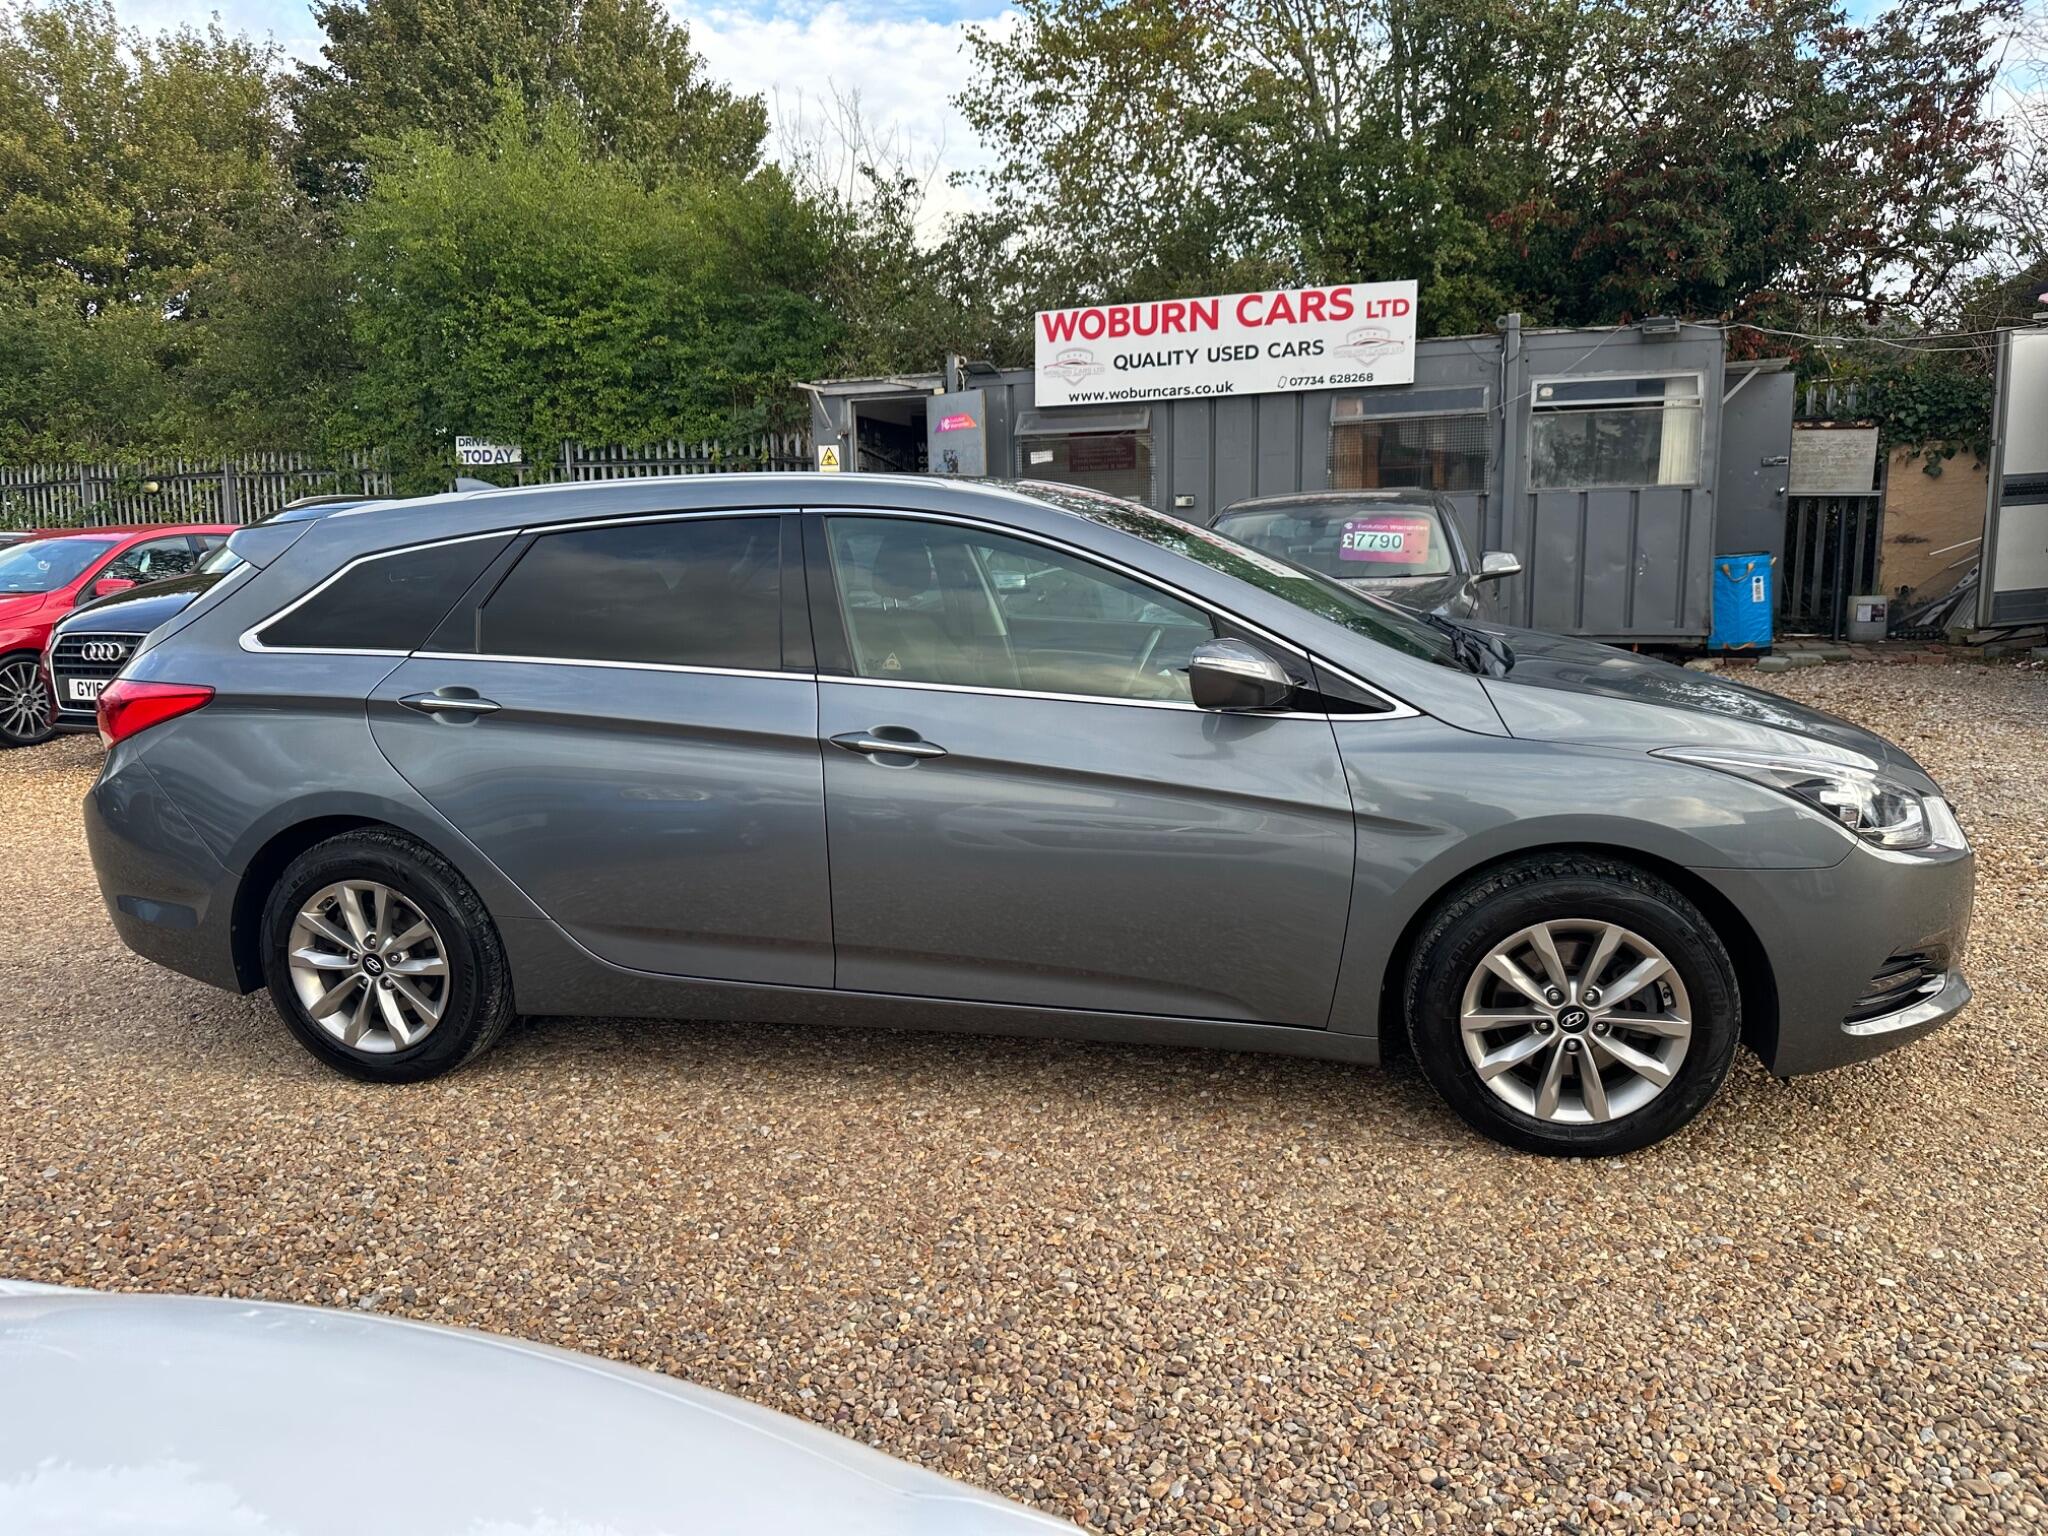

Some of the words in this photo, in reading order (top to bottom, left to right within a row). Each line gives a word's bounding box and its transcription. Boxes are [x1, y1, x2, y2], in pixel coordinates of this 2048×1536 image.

[1041, 298, 1220, 343] WOBURN
[1235, 287, 1355, 330] CARS
[1366, 298, 1410, 320] LTD
[1113, 348, 1199, 371] QUALITY
[1207, 343, 1260, 363] USED
[1268, 339, 1325, 359] CARS
[1289, 375, 1325, 387] 07734
[1329, 372, 1374, 385] 628268
[1068, 380, 1234, 402] www.woburncars.co.uk
[458, 438, 488, 447] DRIVE
[463, 449, 514, 463] TODAY
[1342, 533, 1403, 549] £7790
